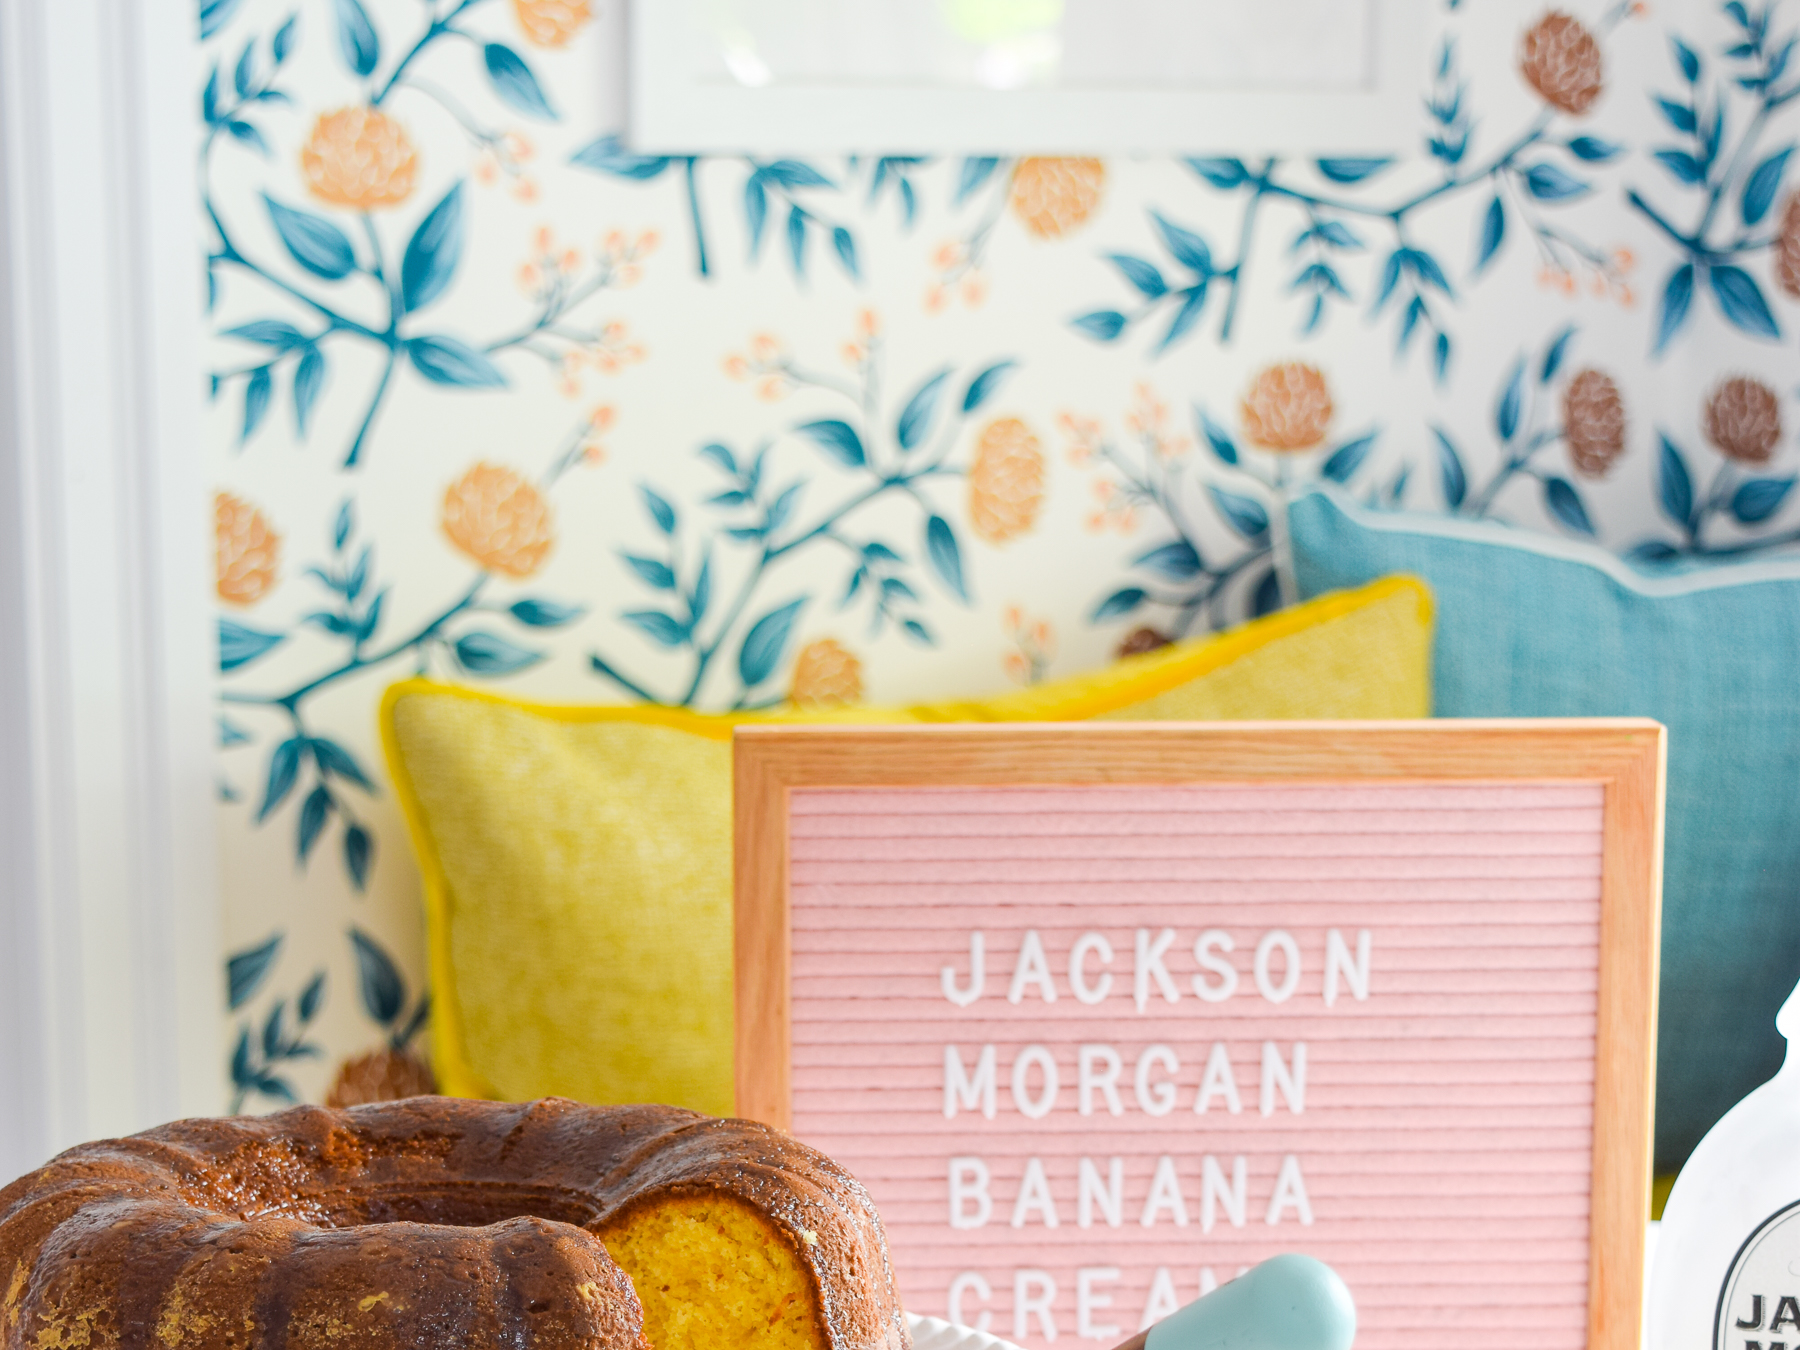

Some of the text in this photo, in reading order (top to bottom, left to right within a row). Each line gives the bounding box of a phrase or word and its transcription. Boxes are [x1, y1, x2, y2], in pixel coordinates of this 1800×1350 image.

[940, 928, 1372, 1013] JACKSON
[943, 1041, 1307, 1119] MORGAN
[948, 1154, 1314, 1234] BANANA
